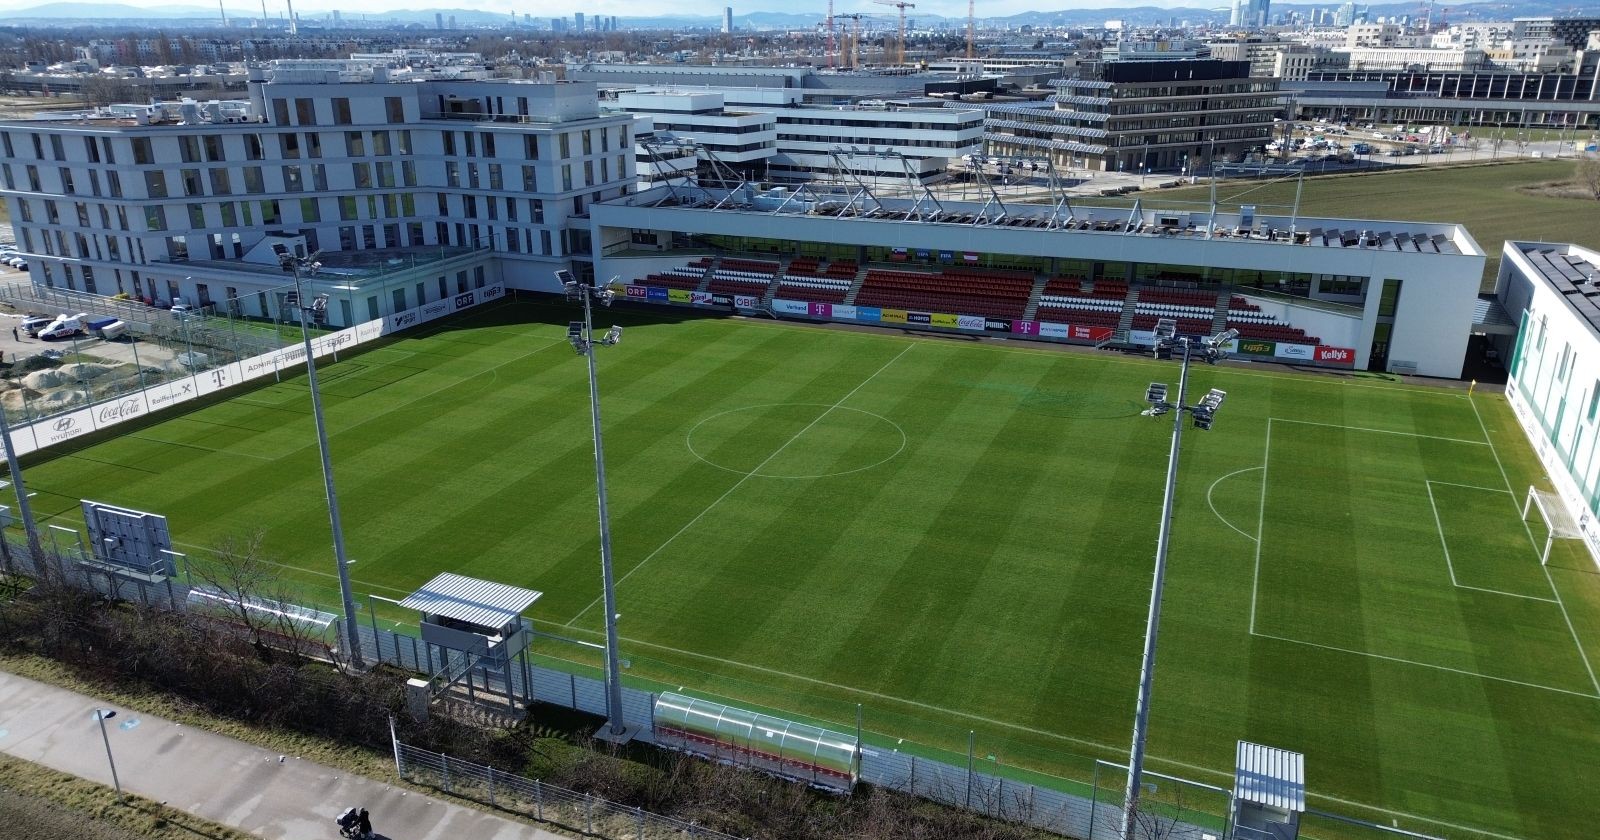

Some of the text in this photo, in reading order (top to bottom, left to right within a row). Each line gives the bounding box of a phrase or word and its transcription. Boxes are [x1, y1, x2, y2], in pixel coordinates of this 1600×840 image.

[483, 286, 501, 298] tipp3
[627, 288, 645, 296] ORF
[456, 294, 474, 306] ORF
[815, 304, 825, 315] T
[958, 318, 984, 328] Coca-Cola
[985, 321, 1004, 329] PUMA
[1020, 322, 1031, 333] T
[1321, 349, 1347, 360] Kelly's
[211, 369, 226, 388] T
[152, 392, 182, 405] Raiffeisen
[99, 399, 140, 423] Coca-Cola
[50, 428, 82, 442] HYUNDAI
